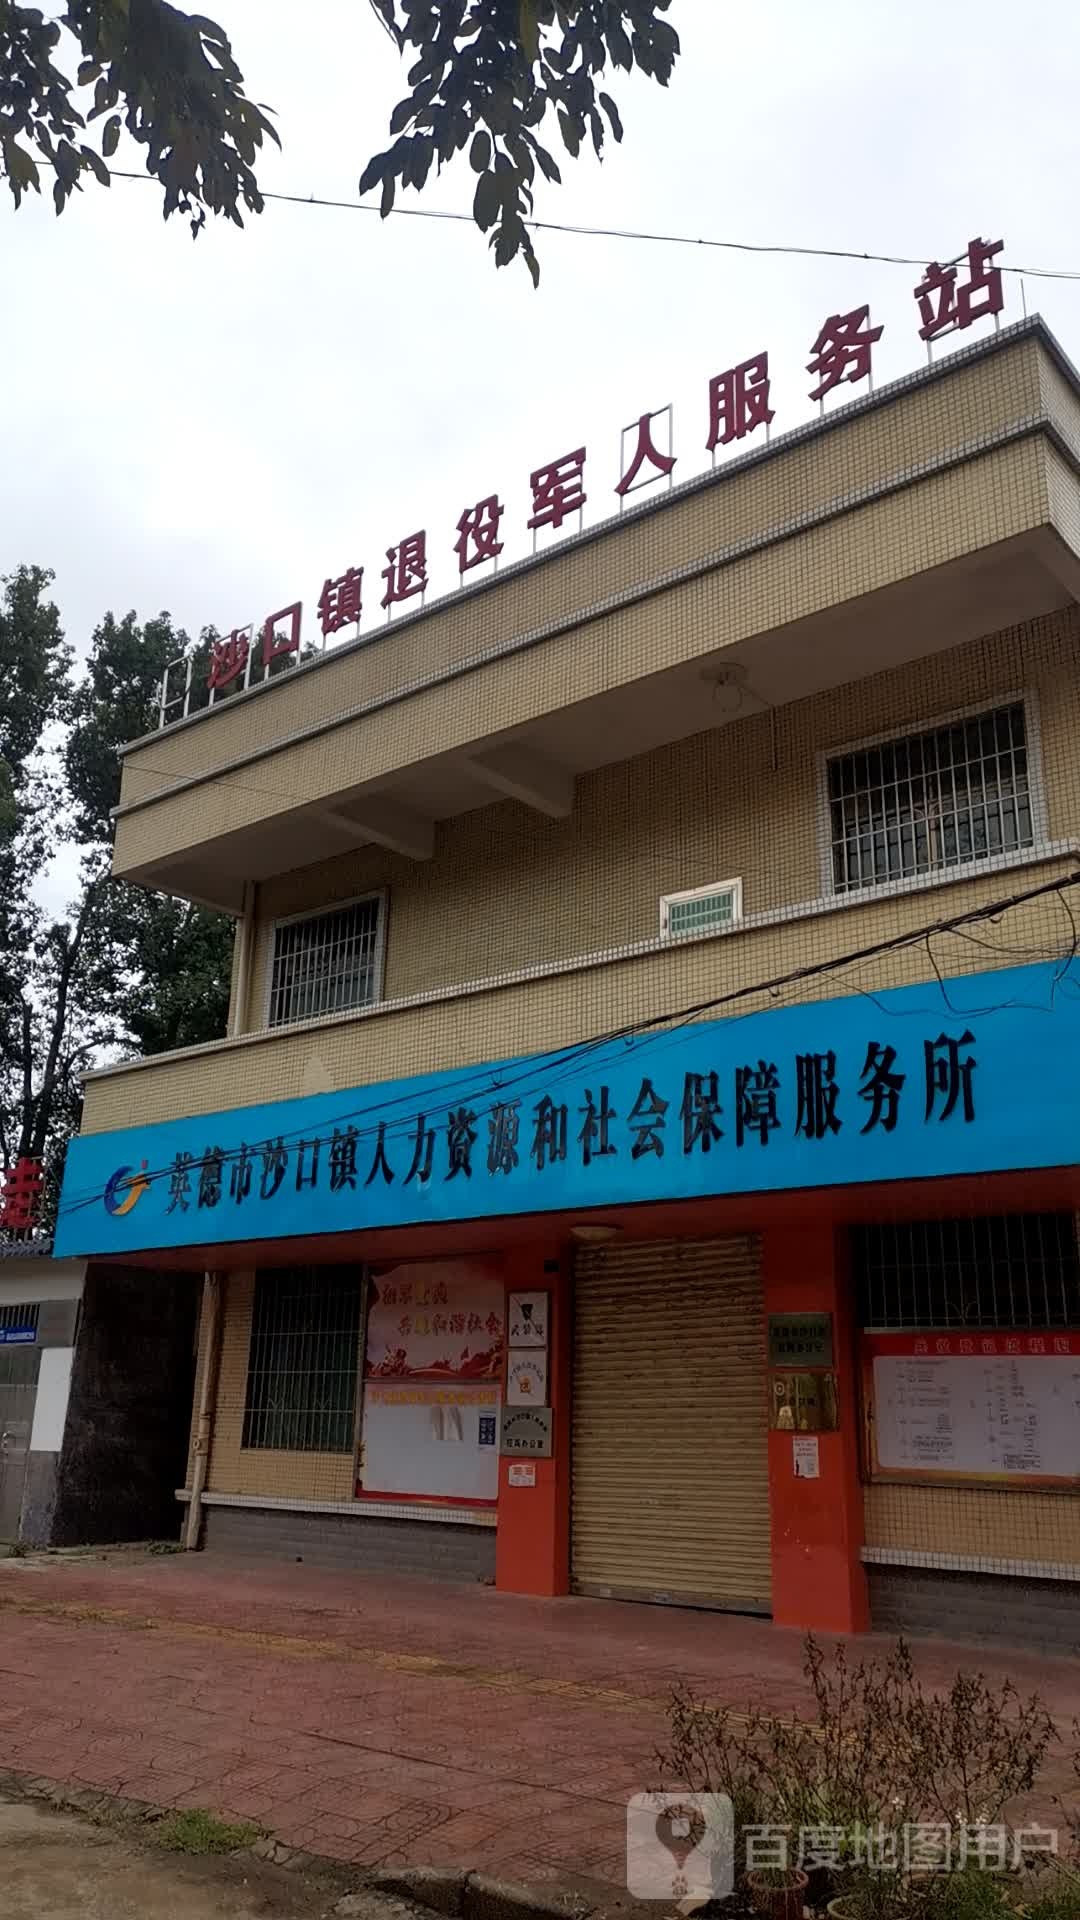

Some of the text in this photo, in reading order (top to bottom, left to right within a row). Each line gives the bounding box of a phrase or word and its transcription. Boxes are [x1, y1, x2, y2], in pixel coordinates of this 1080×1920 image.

[208, 237, 1004, 689] 沙口镇退役军人服务站
[166, 1032, 977, 1214] 英德市沙口镇人力资源和社会保障服务所
